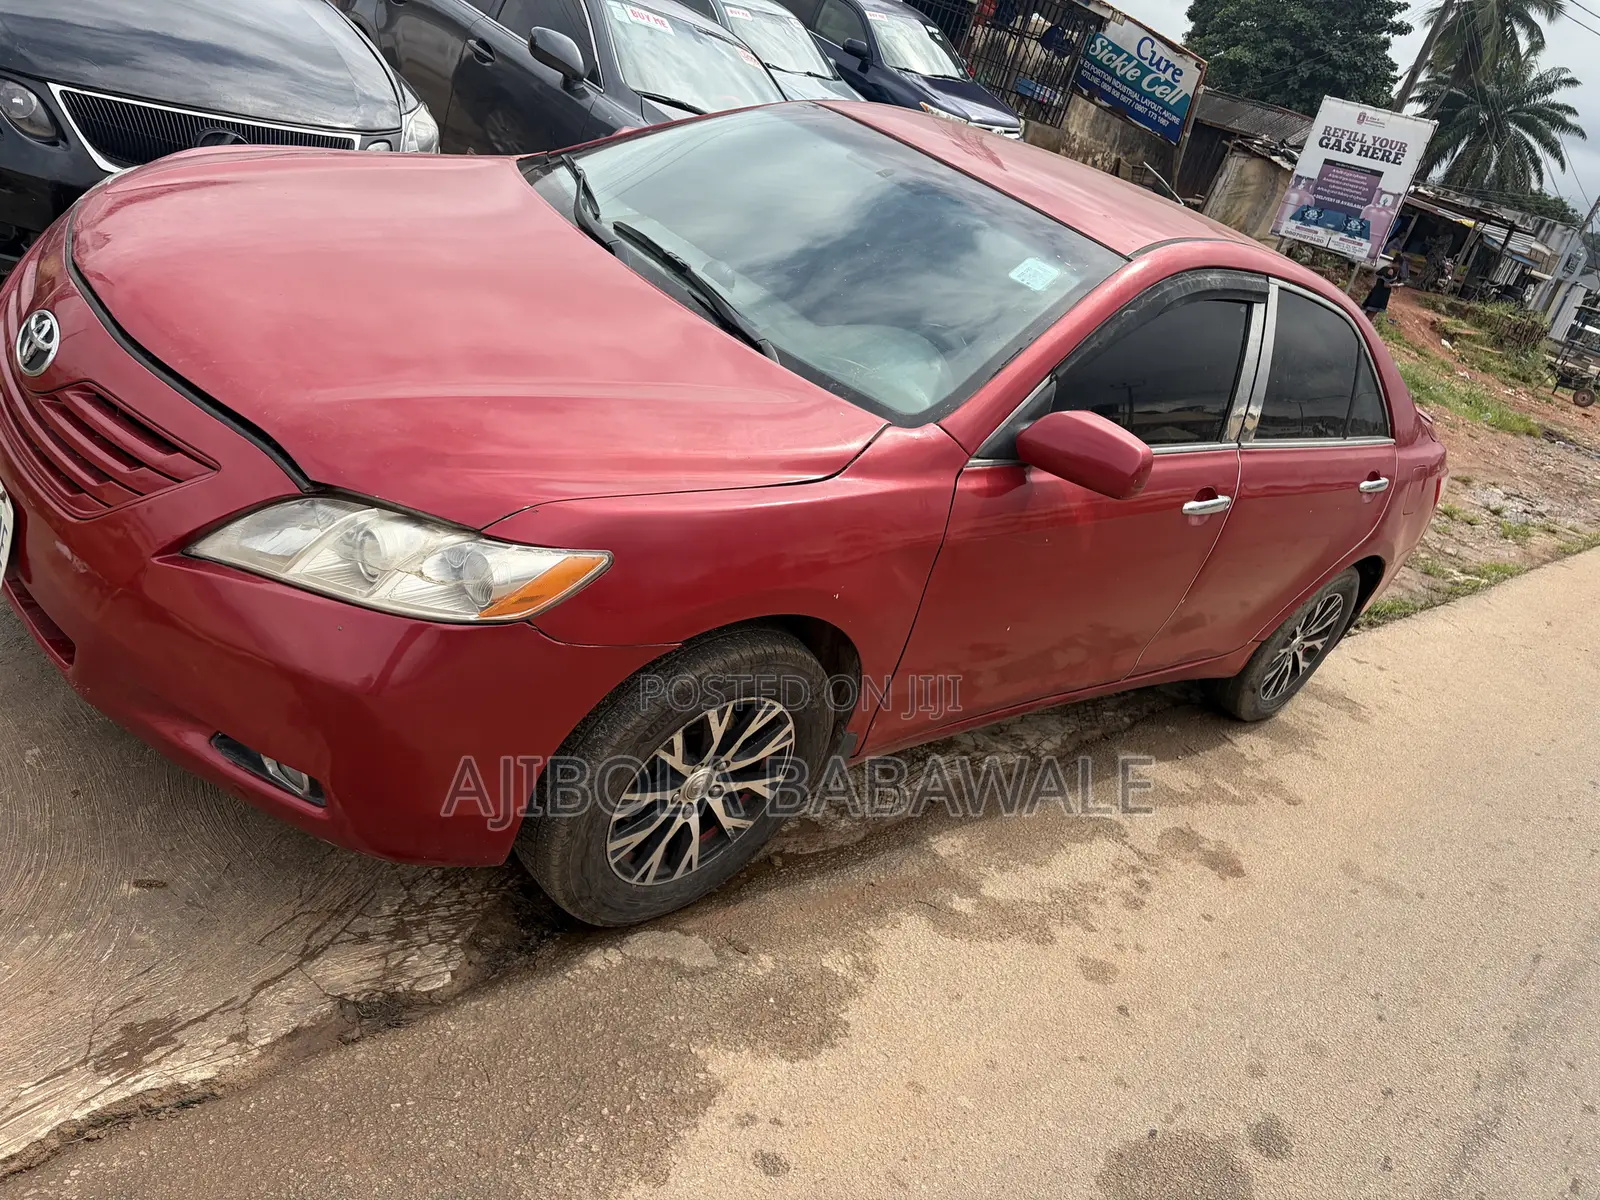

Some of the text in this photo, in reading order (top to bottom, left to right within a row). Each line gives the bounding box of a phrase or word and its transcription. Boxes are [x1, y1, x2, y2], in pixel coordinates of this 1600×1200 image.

[630, 8, 669, 29] BUY ME
[1088, 37, 1186, 106] Sickle Cell
[1136, 36, 1184, 84] Cure
[1111, 78, 1141, 102] INDUSTRIAL
[1318, 135, 1406, 166] GAS HERE
[1322, 125, 1409, 153] REFILL YOUR
